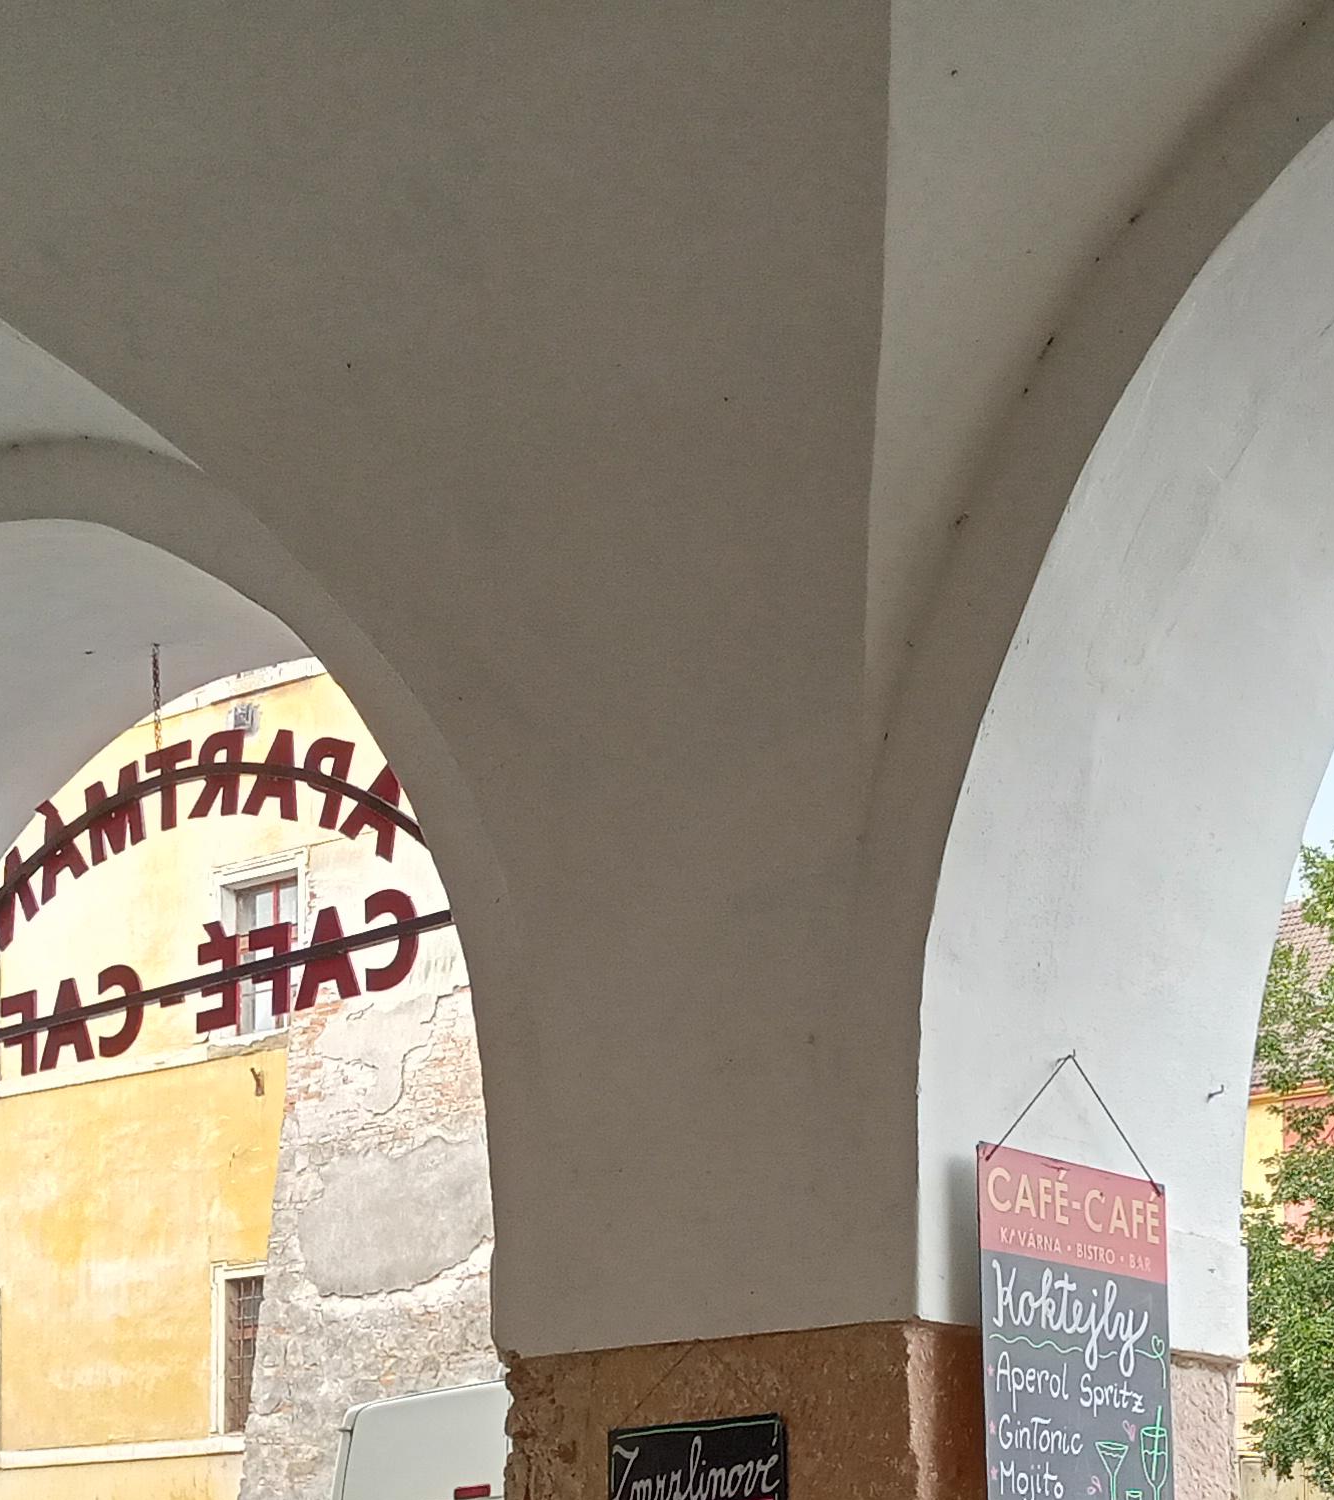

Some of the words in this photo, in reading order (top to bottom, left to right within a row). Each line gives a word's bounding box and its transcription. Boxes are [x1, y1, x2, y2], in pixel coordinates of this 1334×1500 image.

[1076, 1243, 1116, 1265] BISTRO
[1129, 1254, 1151, 1272] BAR
[991, 1258, 1149, 1377] Koktejly
[996, 1351, 1069, 1413] Aperol
[1079, 1373, 1145, 1418] Spritz
